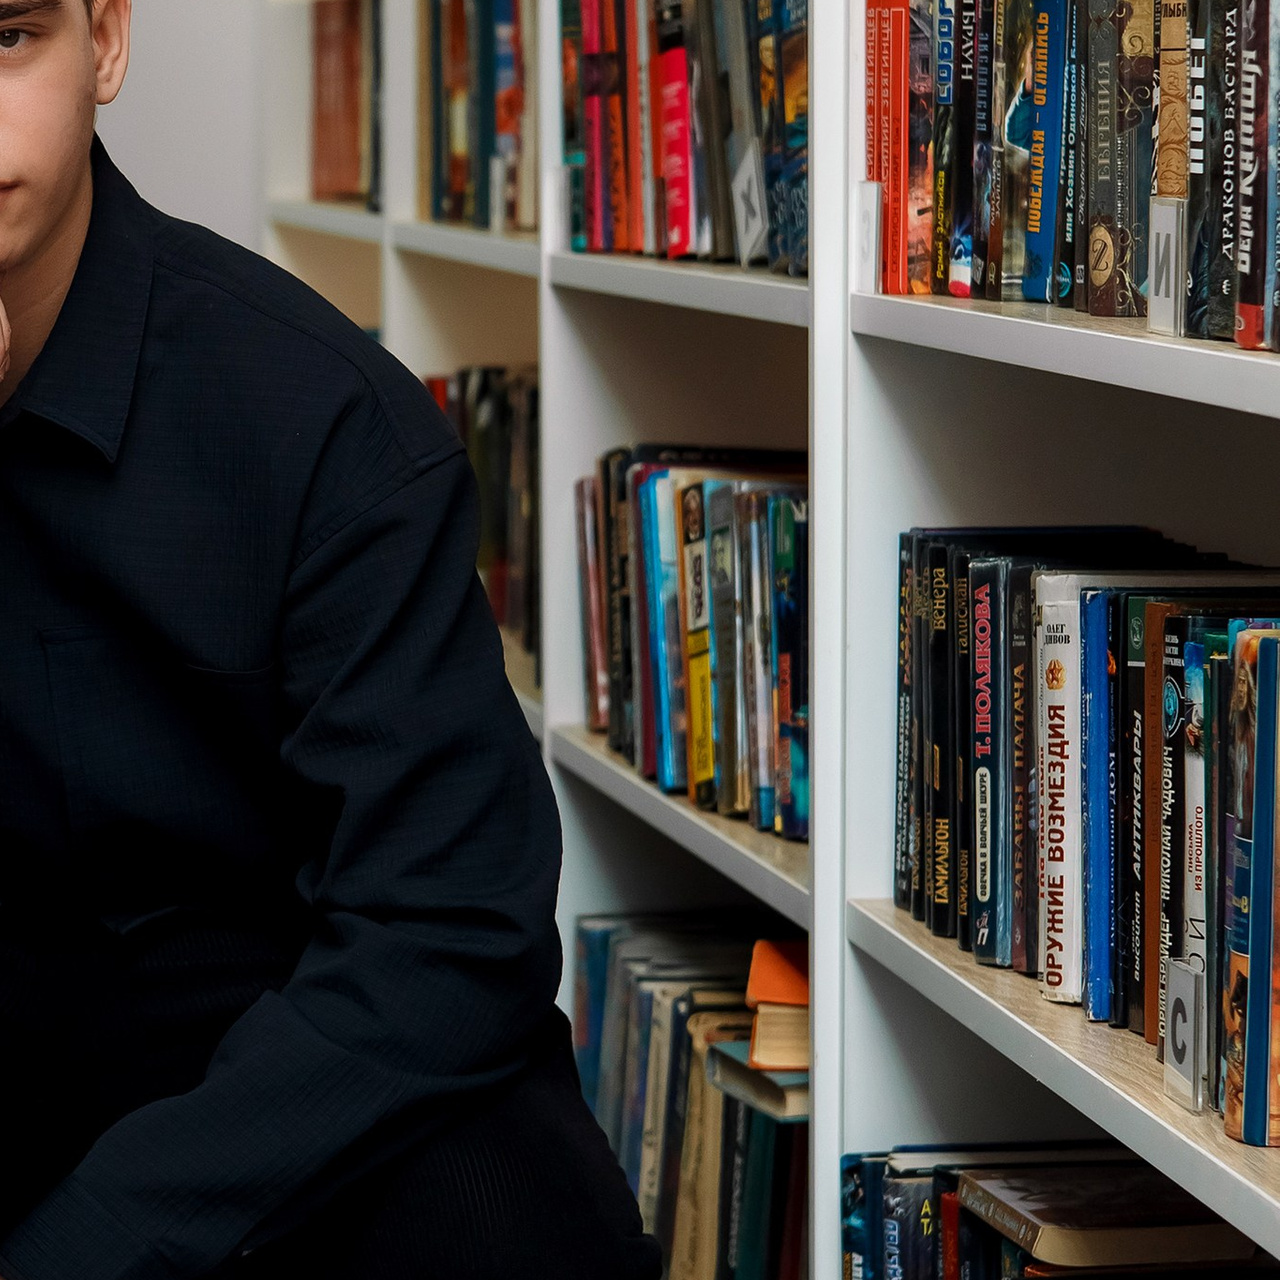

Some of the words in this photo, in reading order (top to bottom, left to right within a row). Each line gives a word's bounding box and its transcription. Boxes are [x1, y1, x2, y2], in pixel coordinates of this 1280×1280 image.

[881, 7, 891, 107] ЗВЯГИНЦЕВ
[961, 11, 977, 81] БРАУН
[1032, 12, 1049, 107] ОГЛЯНИСЬ
[1223, 7, 1238, 120] БАСТАРД
[1066, 63, 1077, 146] Одинокой
[1096, 60, 1112, 183] ЕВГЕНИЯ
[1188, 35, 1206, 175] ПОБЕГ
[935, 170, 946, 234] ЗЛОТНИКОВ
[1026, 129, 1046, 234] ПОБЕЖДАЯ
[1065, 149, 1076, 209] Хозяин
[1220, 128, 1235, 261] ДРАКОНОВ
[891, 206, 900, 274] СКОРПИОН
[1154, 232, 1172, 299] И
[974, 582, 992, 734] ПОЛЯКОВА
[1044, 634, 1071, 645] ДИВОВ
[1046, 623, 1067, 634] ОЛЕГ
[975, 736, 991, 759] Т.
[1012, 662, 1025, 768] ПАЛАЧА
[978, 772, 988, 805] ШКУРЕ
[1046, 704, 1070, 863] ВОЗМЕЗДИЯ
[1131, 709, 1143, 882] АНТИКВАРЫ
[1161, 745, 1175, 821] ЧАДОВИЧ
[934, 818, 950, 904] ГАМИЛЬТОН
[977, 807, 988, 849] ВОЛЧЬЕЙ
[1013, 784, 1024, 910] ЗАБАВЫ
[1160, 824, 1173, 901] НИКОЛАЙ
[1195, 805, 1204, 873] ПРОШЛОГО
[958, 849, 968, 916] ГАМИЛЬТОН
[978, 860, 988, 897] ОВЕЧКА
[1195, 874, 1204, 892] ИЗ
[1045, 874, 1065, 988] ОРУЖИЕ
[1159, 911, 1173, 985] БРАЙДЕР
[1170, 996, 1188, 1066] С
